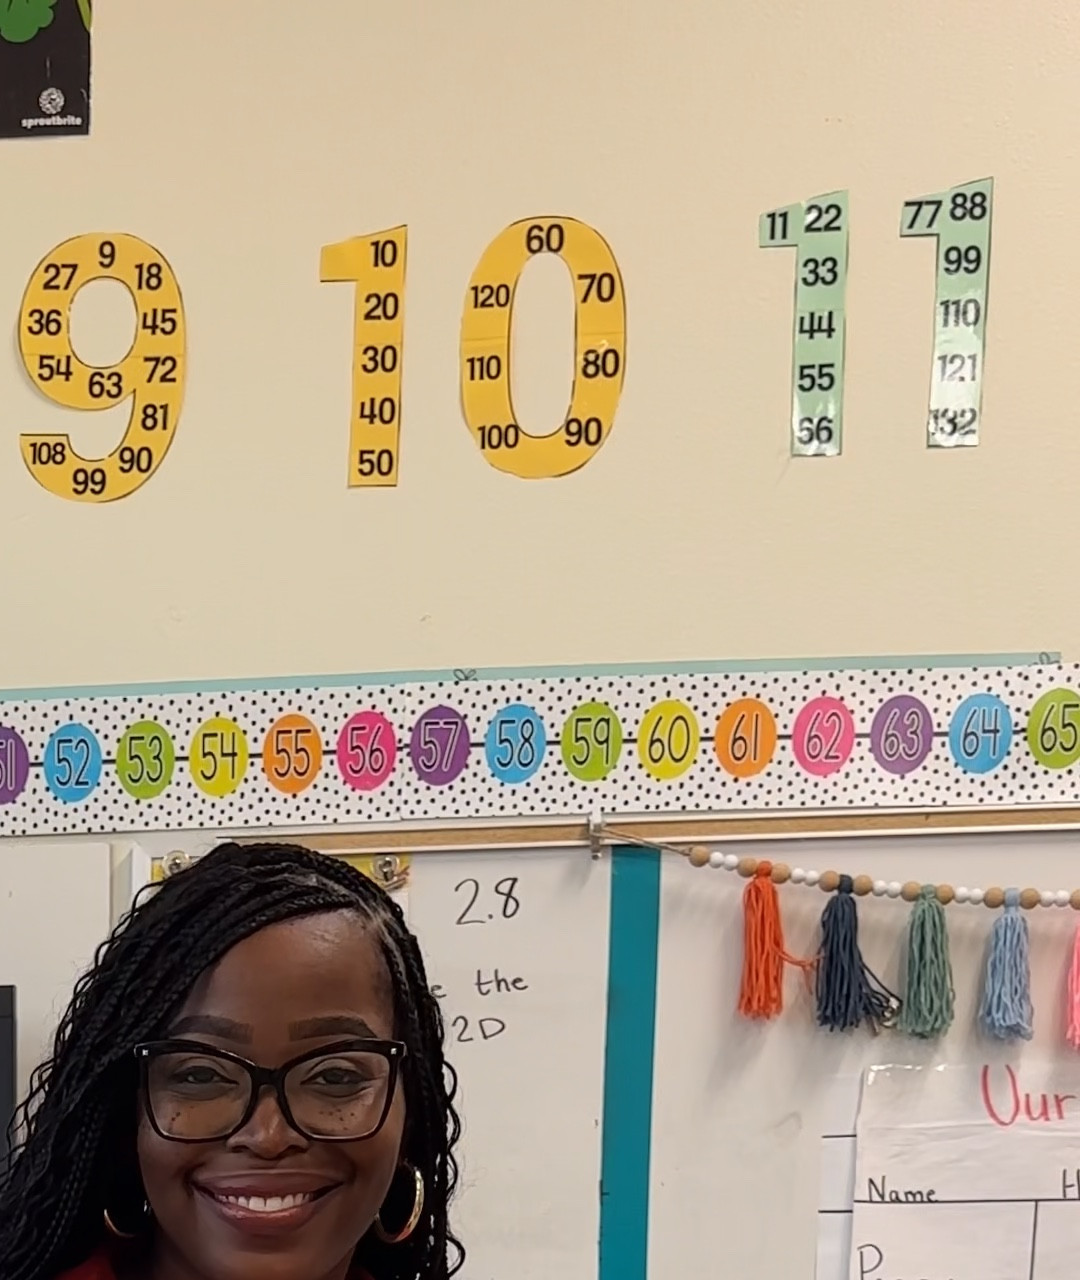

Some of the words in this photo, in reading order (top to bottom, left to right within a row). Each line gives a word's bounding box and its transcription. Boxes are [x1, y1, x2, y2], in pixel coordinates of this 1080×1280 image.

[804, 204, 841, 232] 22
[904, 200, 942, 229] 77
[950, 192, 987, 221] 88
[526, 224, 564, 253] 60
[370, 240, 397, 267] 10
[944, 246, 981, 274] 99
[43, 264, 78, 290] 27
[135, 263, 162, 290] 18
[802, 257, 838, 286] 33
[471, 284, 510, 308] 120
[142, 308, 177, 335] 45
[362, 346, 397, 372] 30
[466, 356, 501, 380] 110
[89, 372, 122, 398] 63
[798, 364, 835, 392] 55
[141, 404, 168, 430] 81
[478, 424, 519, 449] 100
[30, 442, 65, 465] 108
[55, 739, 90, 788] 52
[127, 736, 164, 784] 53
[200, 733, 237, 781] 54
[274, 729, 311, 777] 55
[347, 726, 384, 776] 56
[420, 721, 460, 771] 57
[496, 720, 535, 768] 58
[571, 717, 610, 766] 59
[648, 714, 691, 763] 60
[730, 713, 762, 761] 61
[804, 711, 843, 760] 62
[883, 709, 920, 759] 63
[962, 707, 1000, 757] 64
[1039, 703, 1080, 753] 65
[455, 878, 519, 925] 2.8
[475, 969, 528, 996] the
[868, 1175, 938, 1203] Name
